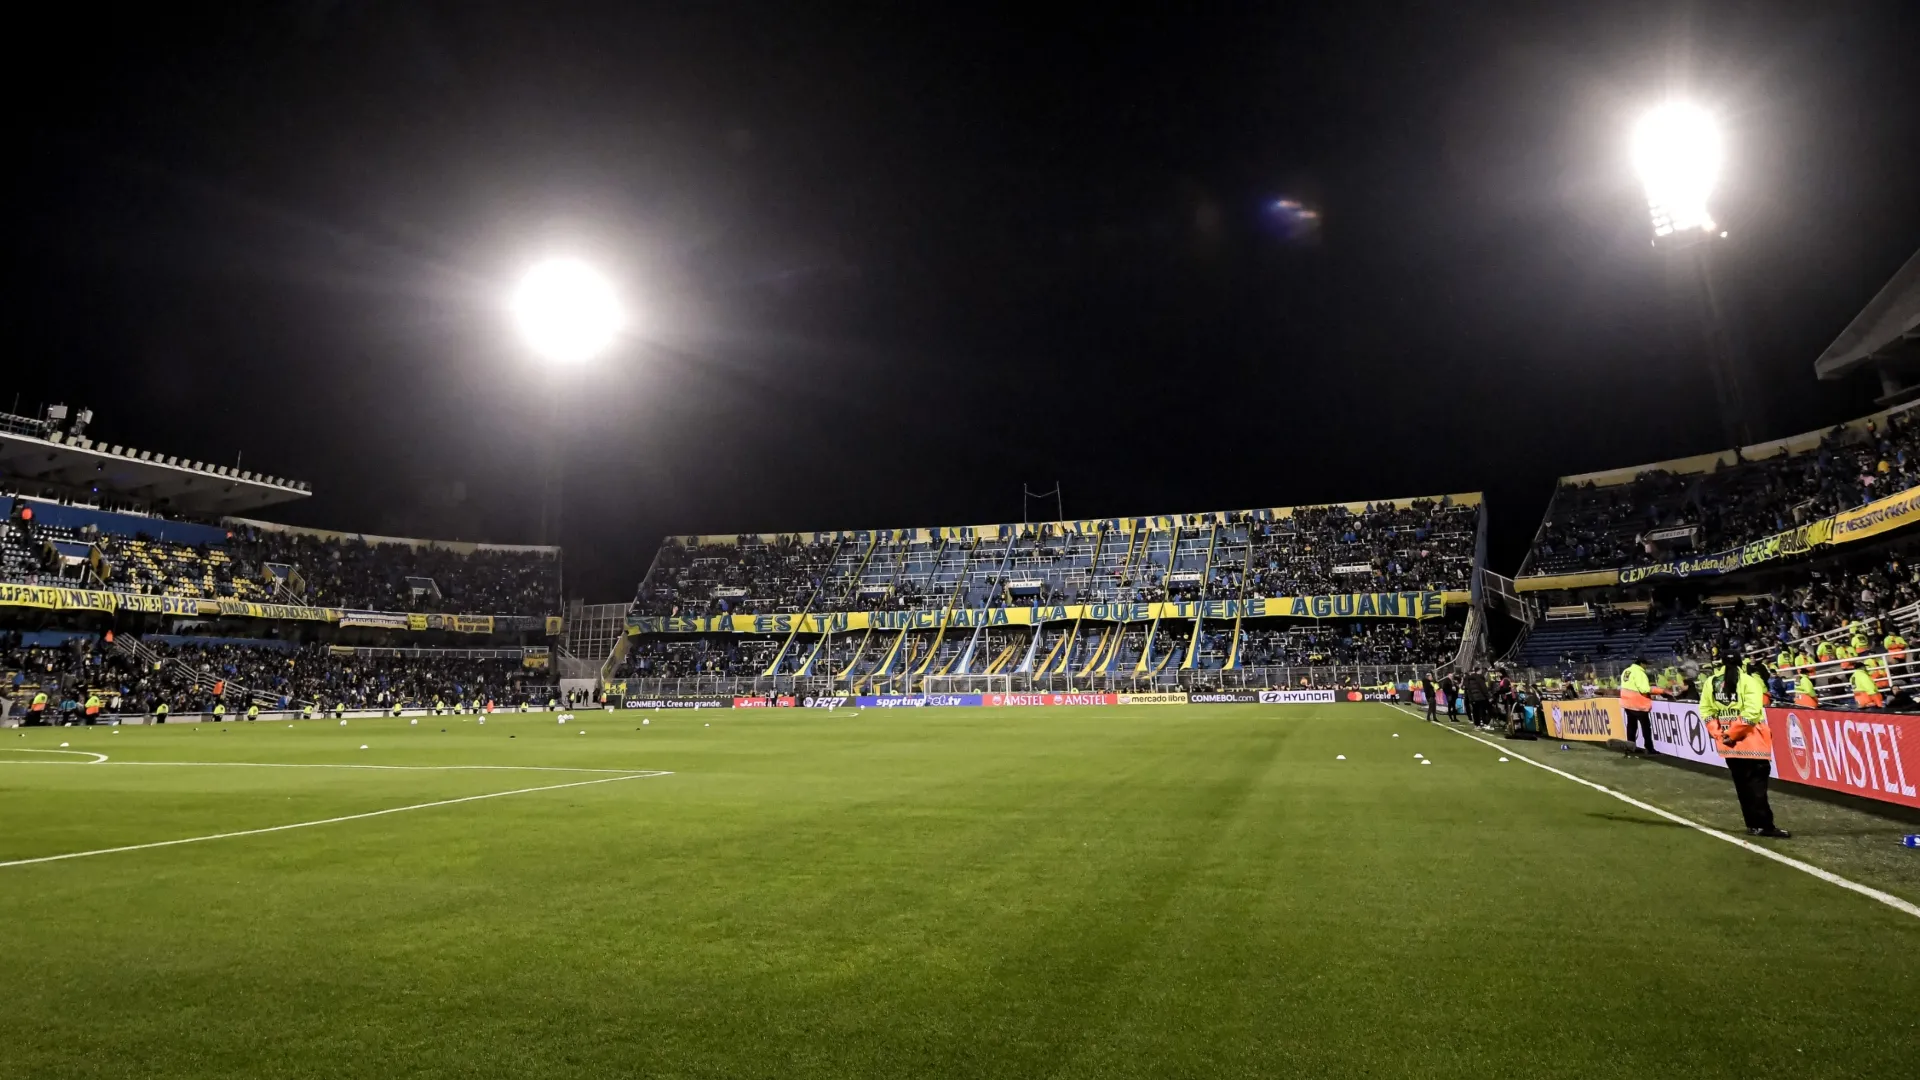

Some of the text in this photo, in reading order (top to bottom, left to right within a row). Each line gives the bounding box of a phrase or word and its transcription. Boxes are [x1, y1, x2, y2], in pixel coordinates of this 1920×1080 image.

[662, 614, 734, 632] ESTA
[754, 615, 792, 632] ES
[812, 612, 848, 633] TU
[868, 608, 1009, 629] HINCHADA
[1031, 604, 1068, 624] LA
[1090, 602, 1149, 620] QUE
[1173, 599, 1266, 617] TIENE
[1290, 590, 1442, 616] AGUANTE
[1003, 695, 1045, 706] AMSTEL
[1064, 694, 1108, 705] AMSTEL
[1131, 694, 1186, 703] mercado libre
[1283, 692, 1333, 701] HYUNDAI
[1364, 691, 1400, 700] priceles
[626, 700, 666, 708] CONMEBOL
[666, 700, 683, 708] Cree
[753, 699, 789, 708] mafre
[1563, 701, 1611, 736] mercado libre
[1650, 711, 1684, 747] UNDAI
[1810, 718, 1917, 798] AMSTEL
